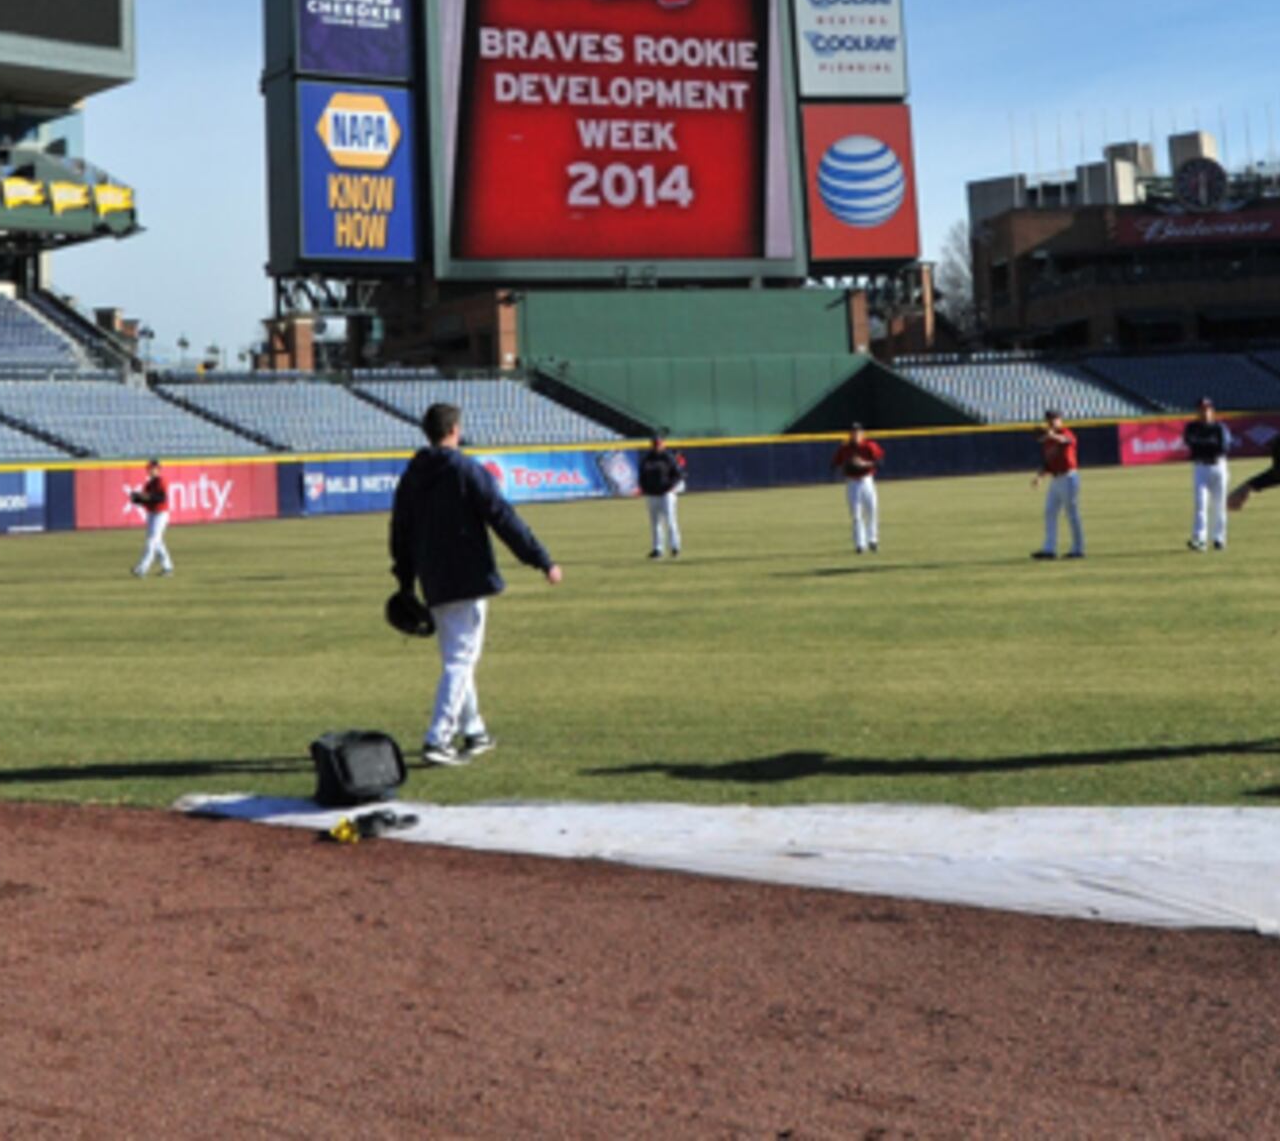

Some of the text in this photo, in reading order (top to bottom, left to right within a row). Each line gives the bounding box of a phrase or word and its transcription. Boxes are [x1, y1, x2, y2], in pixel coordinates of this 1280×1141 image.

[479, 26, 759, 72] BRAVES ROOKIE
[813, 33, 898, 52] COOLRAY
[494, 72, 750, 110] DEVELOPMENT
[332, 112, 389, 149] NAPA
[576, 118, 679, 152] WEEK
[328, 173, 395, 213] KNOW
[566, 162, 694, 209] 2014
[334, 211, 386, 249] HOW
